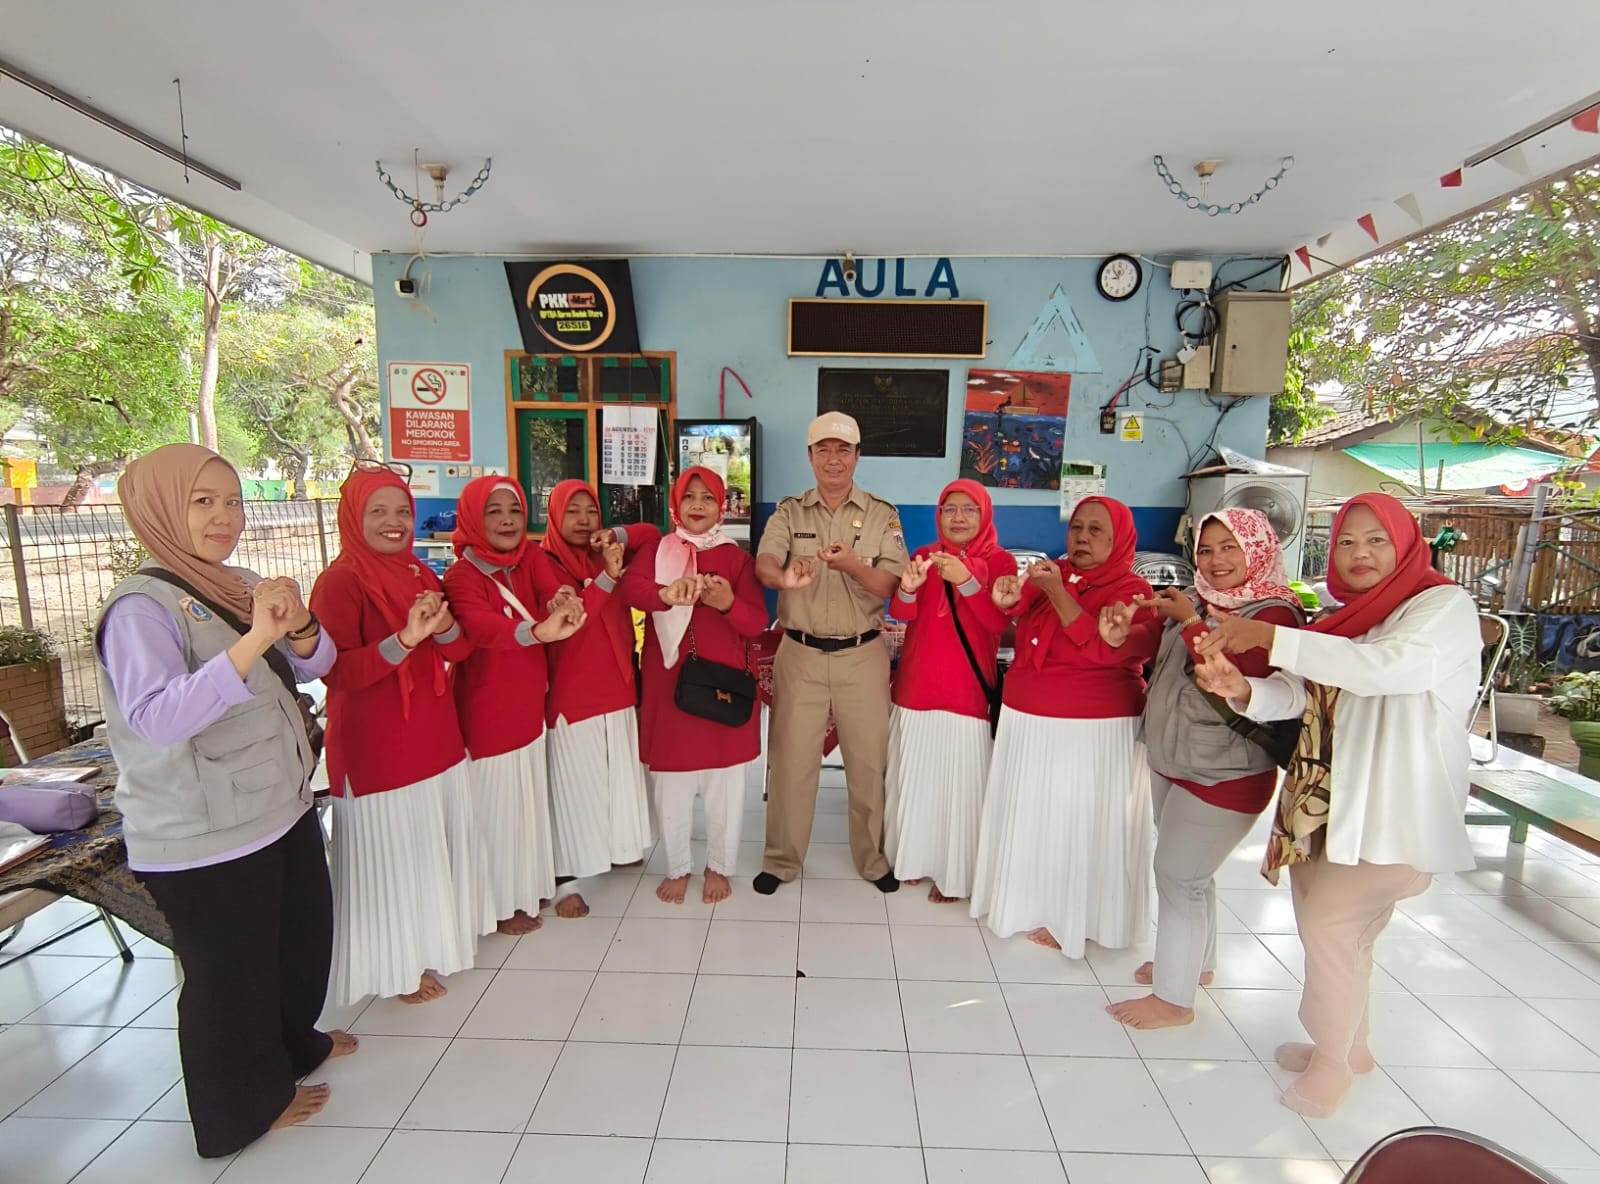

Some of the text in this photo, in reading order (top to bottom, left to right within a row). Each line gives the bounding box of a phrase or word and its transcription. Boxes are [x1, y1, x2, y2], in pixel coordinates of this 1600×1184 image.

[816, 258, 959, 298] AULA
[538, 293, 569, 309] PKK
[558, 321, 589, 329] 26516
[405, 411, 455, 420] KAWASAN
[405, 420, 455, 429] DILARANG
[406, 429, 456, 439] MEROKOK
